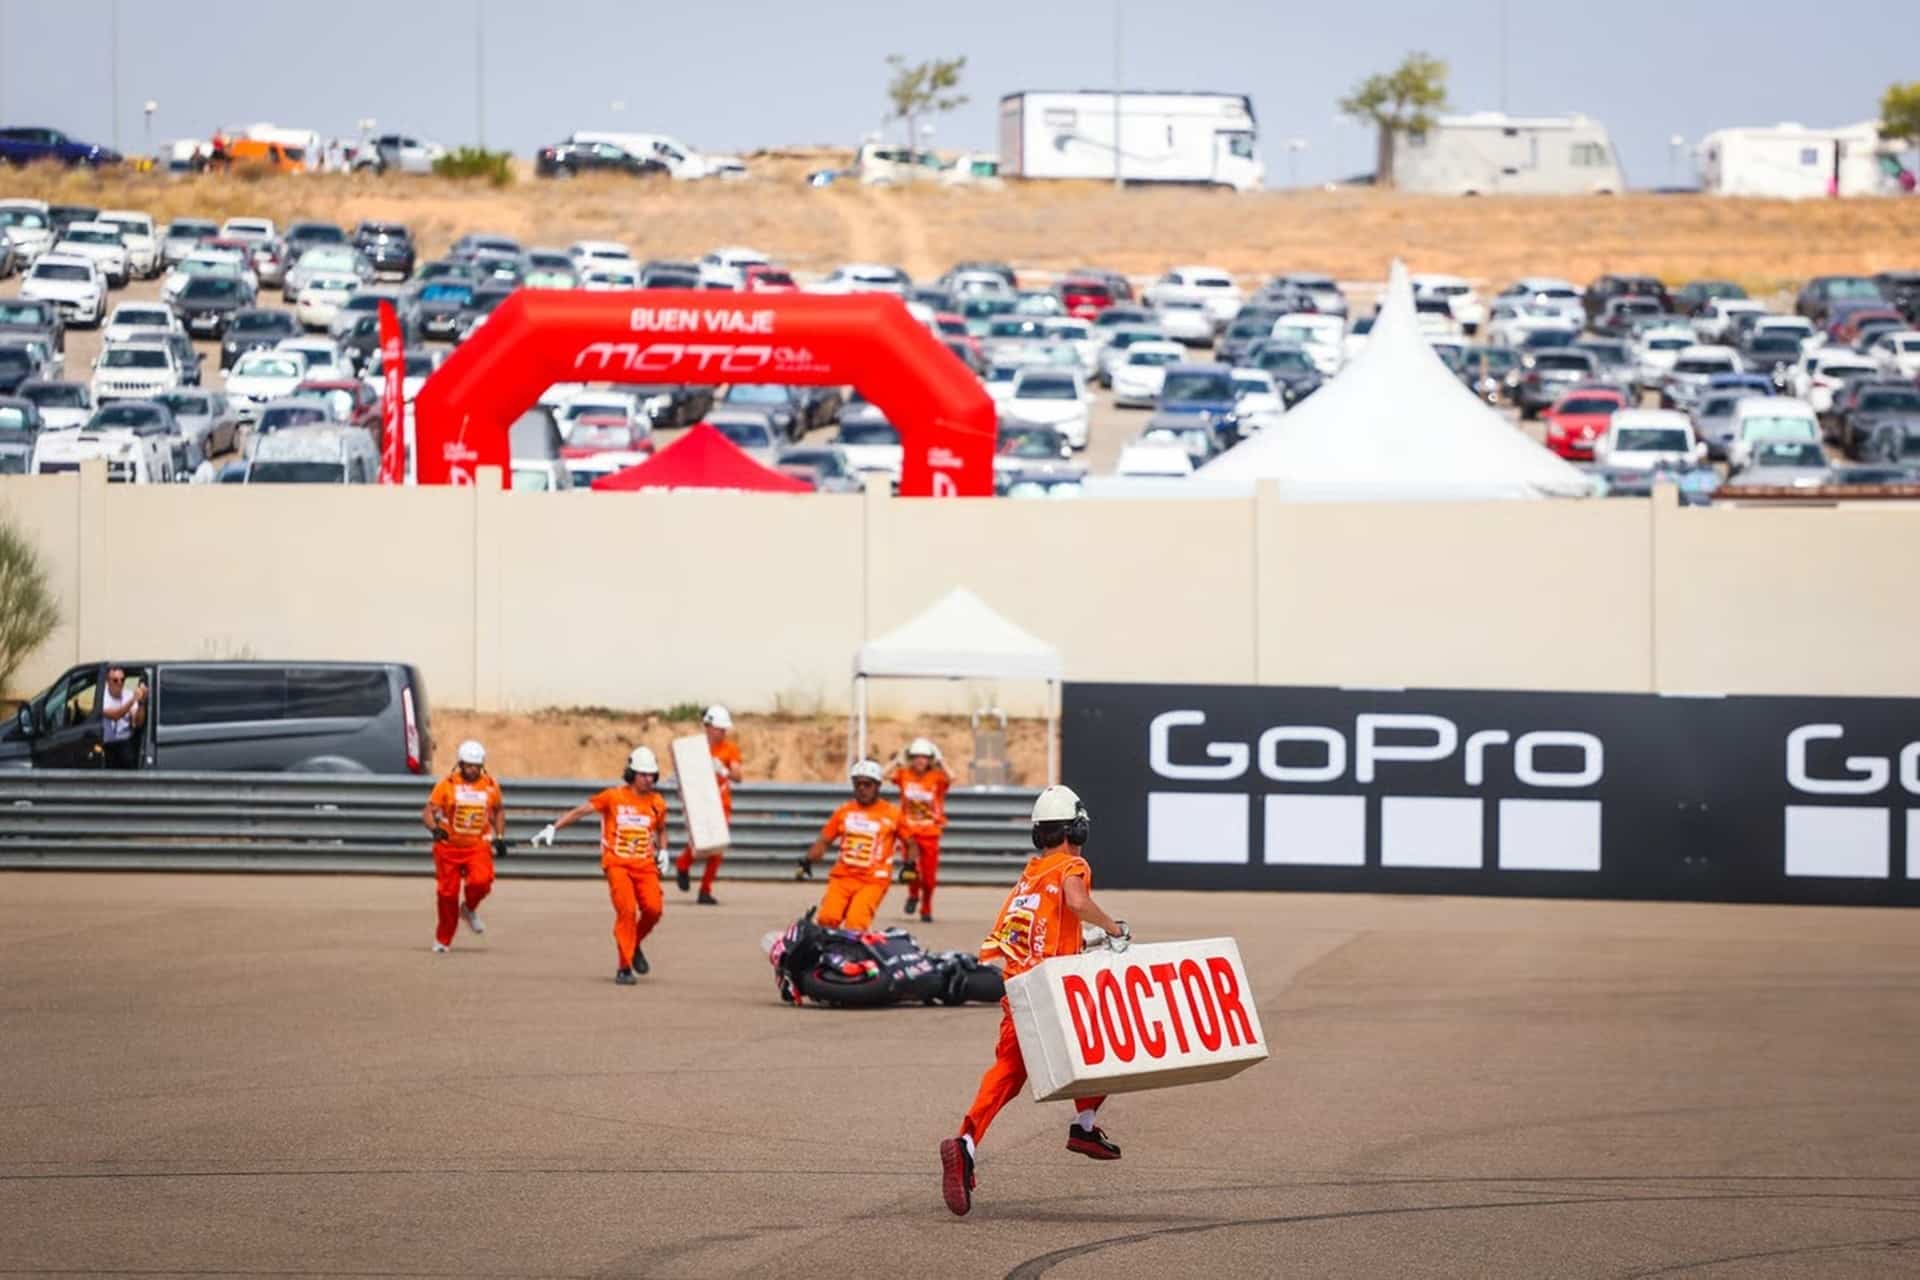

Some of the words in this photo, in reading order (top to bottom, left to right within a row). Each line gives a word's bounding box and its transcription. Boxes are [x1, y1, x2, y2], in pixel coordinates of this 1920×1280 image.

[630, 308, 698, 332] BUEN
[703, 310, 775, 333] VIAJE
[1149, 710, 1603, 787] GoPro
[1786, 723, 1920, 795] G
[1062, 957, 1258, 1066] DOCTOR
